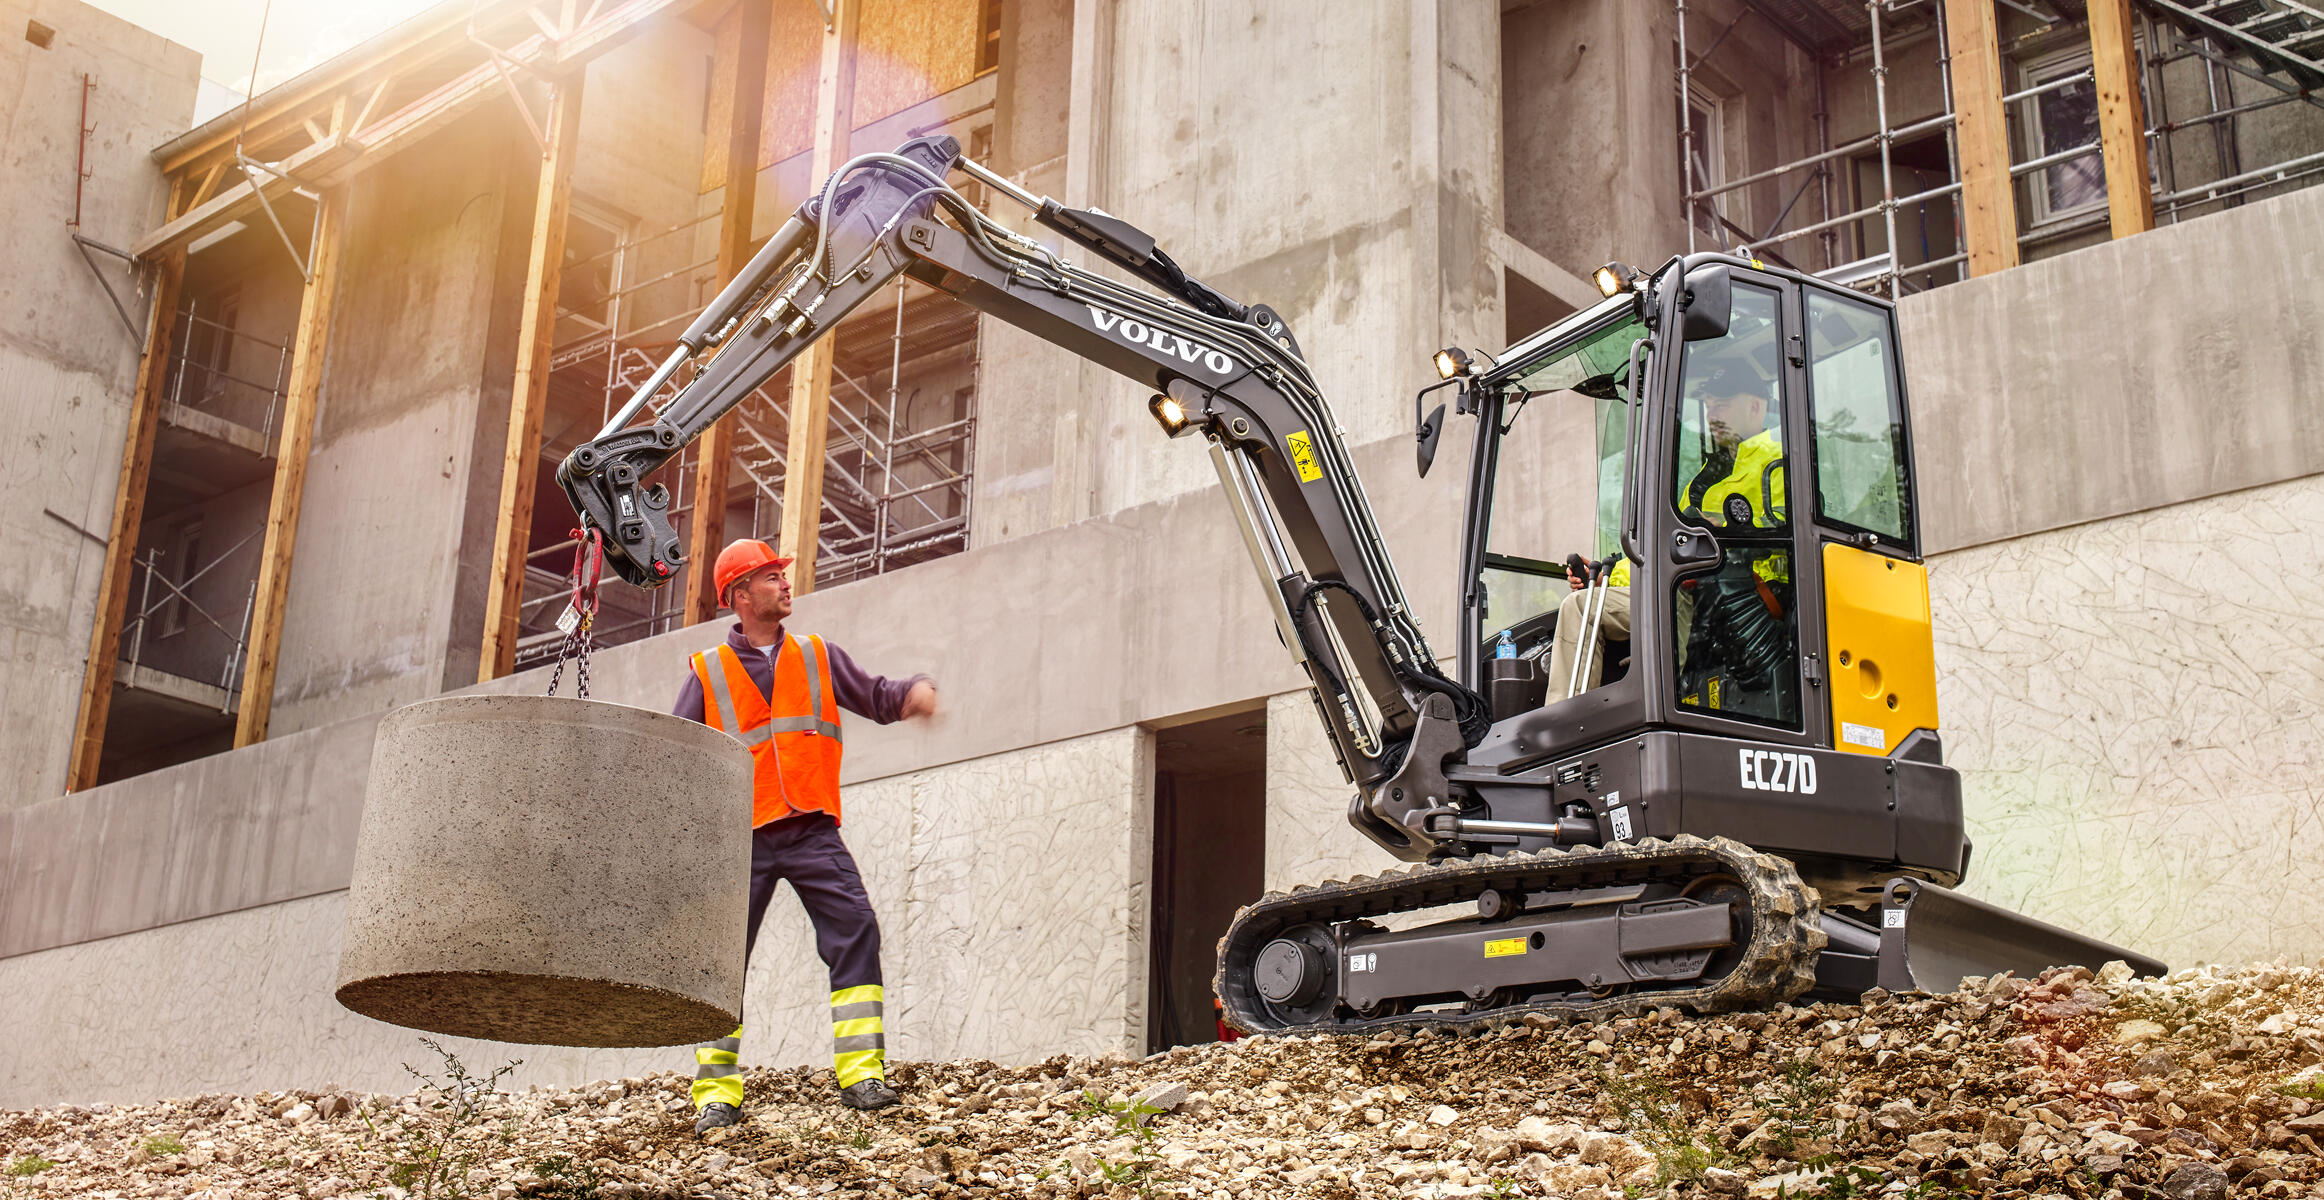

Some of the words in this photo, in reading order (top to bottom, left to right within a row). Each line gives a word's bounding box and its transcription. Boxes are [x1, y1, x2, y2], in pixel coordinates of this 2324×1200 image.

[1086, 304, 1233, 374] VOLVO
[1739, 748, 1817, 795] EC27D
[1615, 822, 1626, 839] 93
